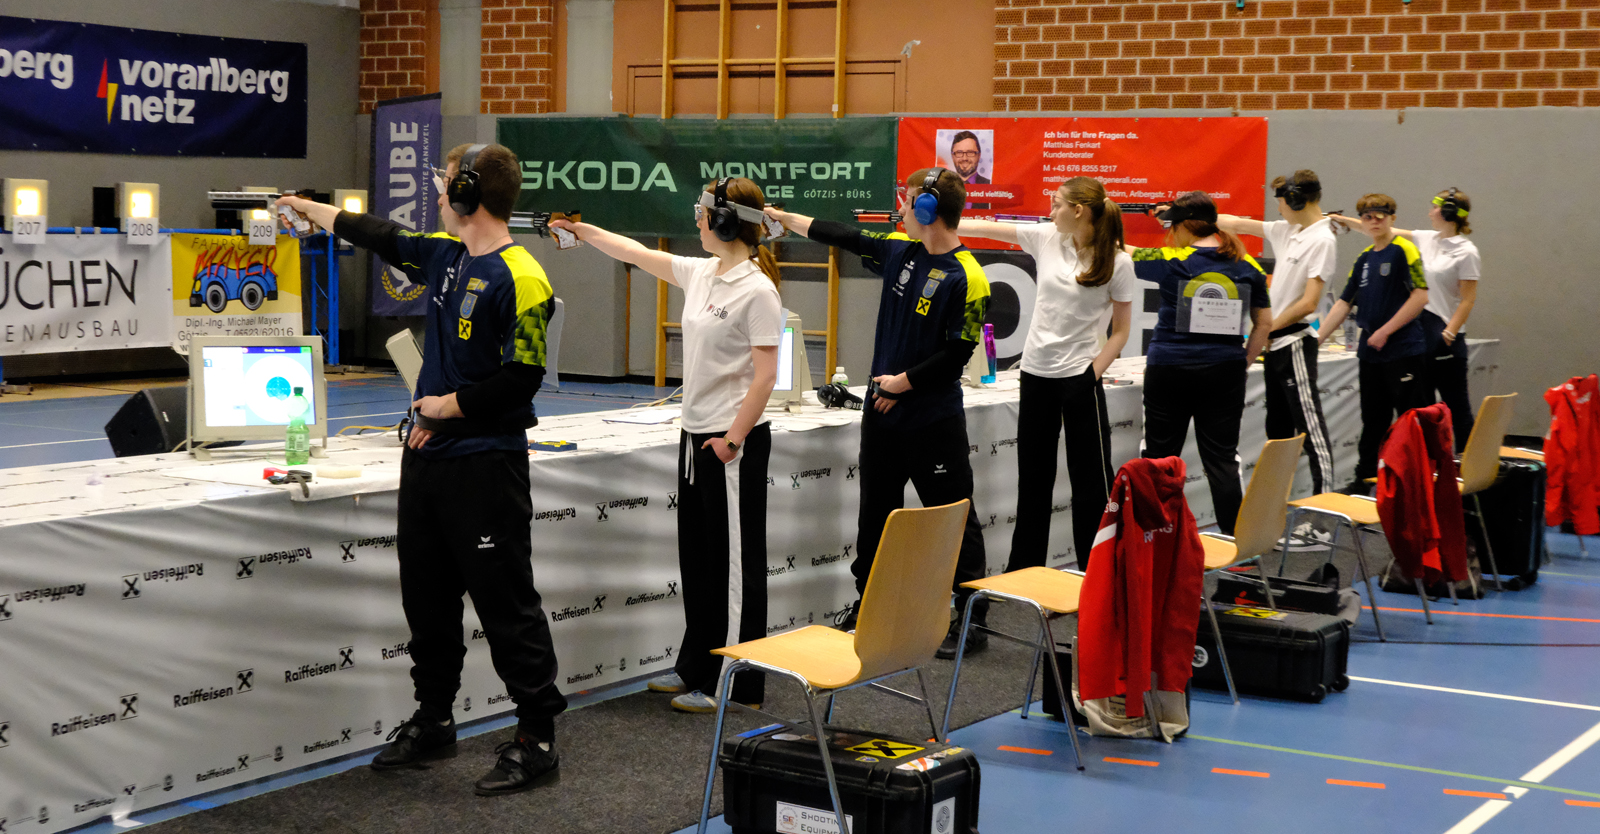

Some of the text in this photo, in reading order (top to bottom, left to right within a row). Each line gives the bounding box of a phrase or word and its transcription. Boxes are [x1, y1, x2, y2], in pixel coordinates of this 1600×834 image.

[119, 57, 289, 103] vorarlberg
[121, 90, 195, 124] netz
[1098, 132, 1125, 140] Fragen
[1075, 141, 1101, 149] Fenkart
[1043, 151, 1094, 159] Kundenberater
[700, 161, 872, 180] MONTFORT
[1052, 164, 1066, 172] +43
[1066, 164, 1080, 172] 676
[803, 188, 837, 199] GÖTZIS
[846, 187, 872, 199] BÜRS
[17, 221, 41, 236] 207
[131, 223, 153, 237] 208
[252, 225, 273, 238] 209
[191, 236, 279, 251] FAHRSC
[193, 245, 278, 279] MAYER
[186, 316, 282, 329] Dipl.-Ing. Michael Mayer
[801, 467, 832, 479] Raiffeisen
[609, 496, 649, 510] Raiffeisen
[535, 507, 576, 522] Raiffeisen
[357, 534, 397, 549] iffeisen
[259, 547, 313, 565] Raiffeisen
[811, 553, 841, 567] Raiffeisen
[143, 562, 204, 583] Raiffeisen
[15, 583, 86, 603] Raiffeisen
[625, 592, 665, 607] Raiffeisen
[551, 606, 591, 623] Raiffeisen
[381, 642, 410, 660] Raiffe
[639, 654, 664, 667] Raiffeisen
[285, 663, 337, 684] Raiffeisen
[566, 671, 594, 685] Raiffeisen
[173, 686, 233, 708] Raiffeisen
[487, 692, 513, 706] Raiffeis
[51, 712, 116, 737] Raiffeisen
[303, 738, 339, 754] Raiffeisen
[196, 765, 236, 783] Raiffeisen
[801, 811, 839, 825] SHOOTIN
